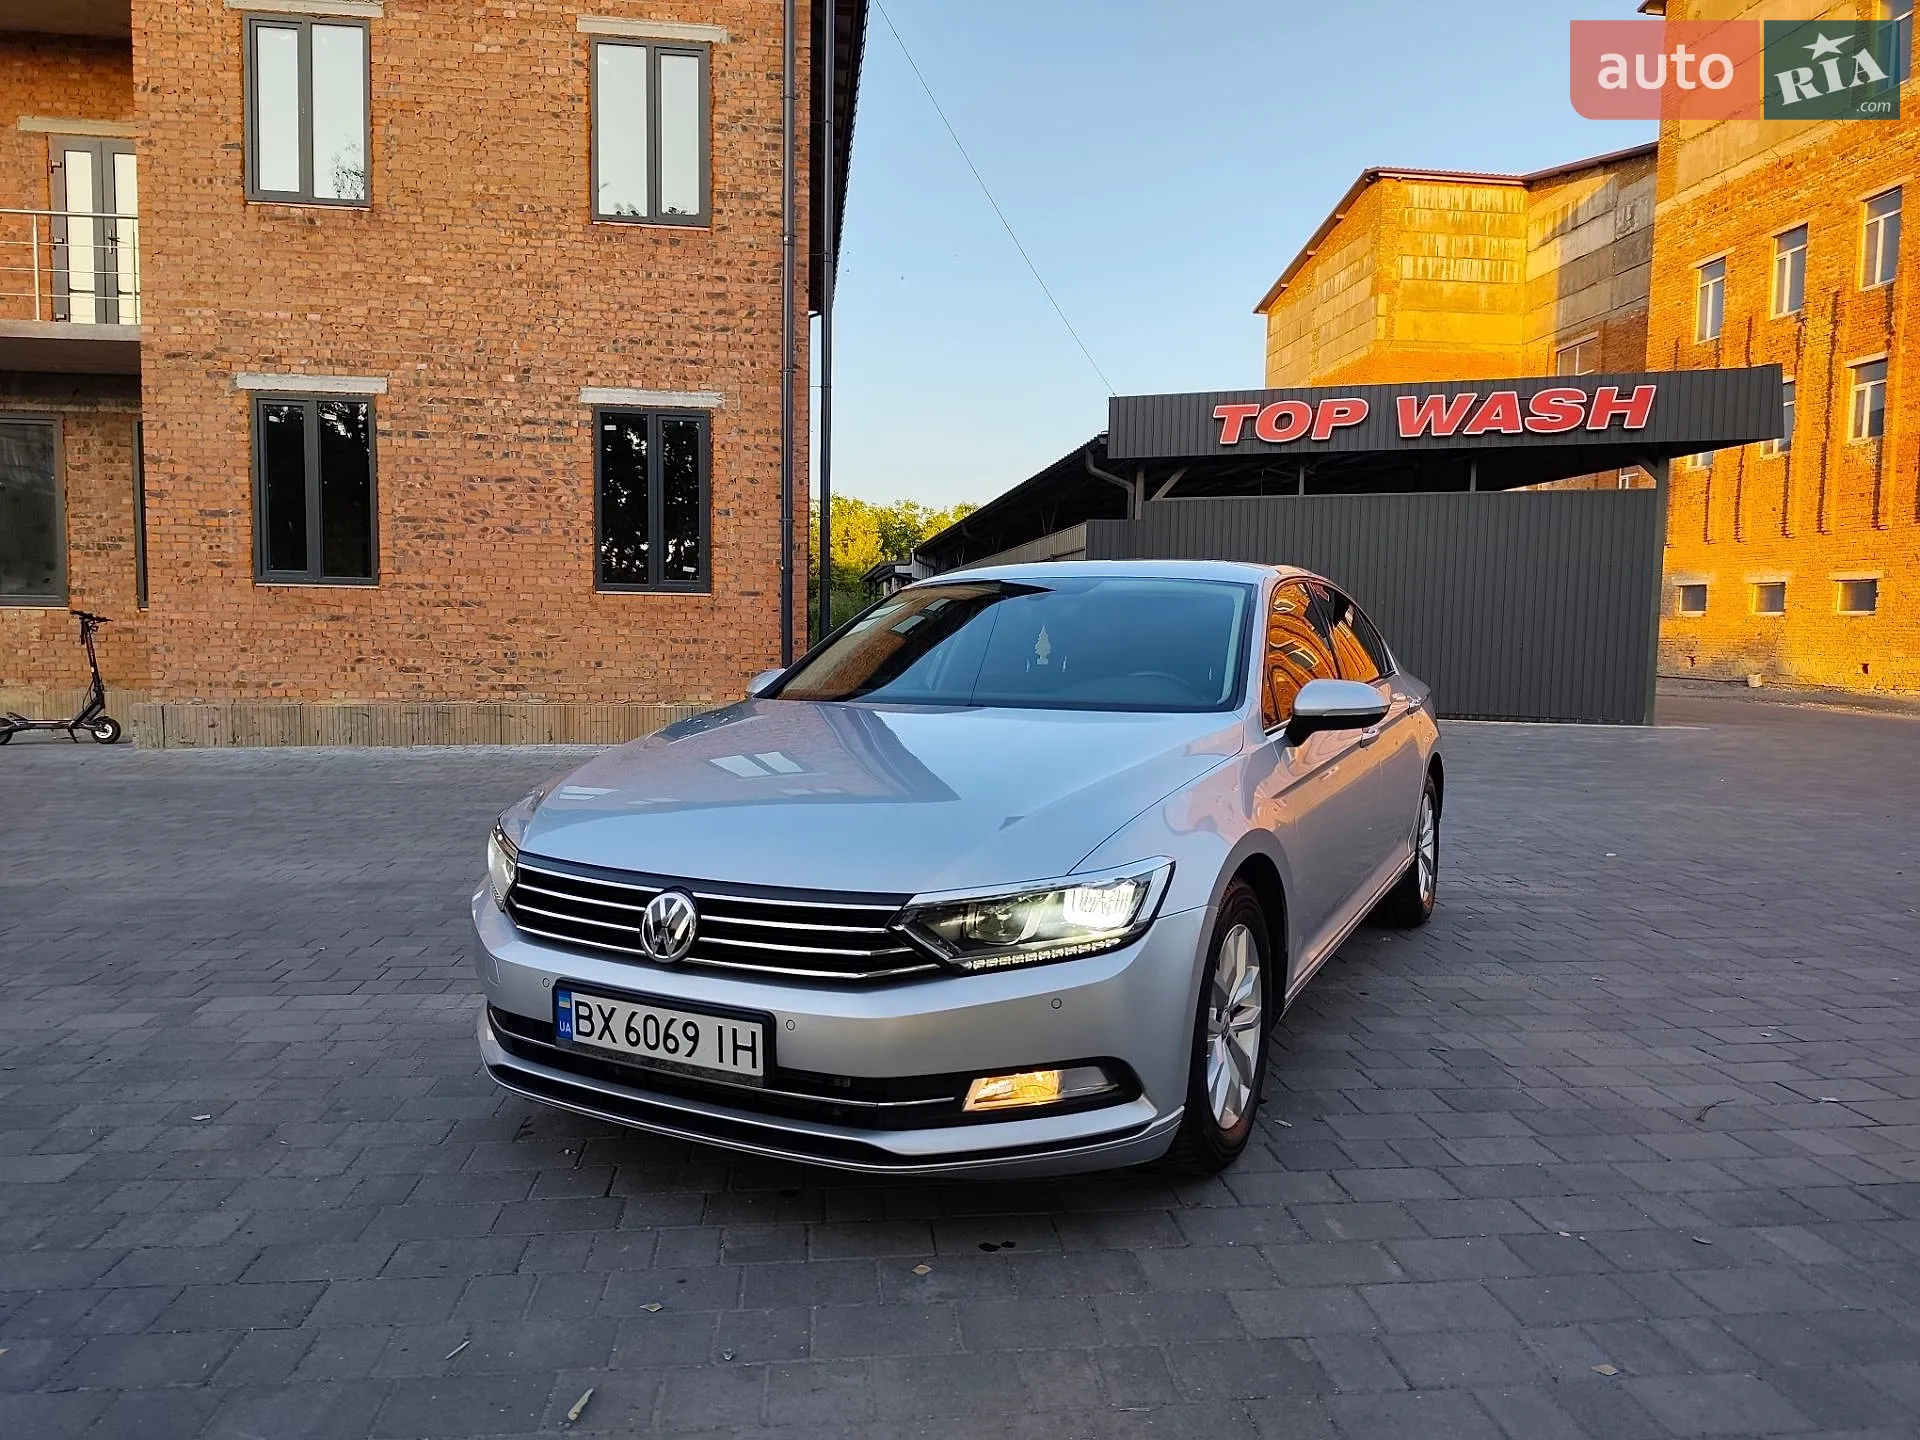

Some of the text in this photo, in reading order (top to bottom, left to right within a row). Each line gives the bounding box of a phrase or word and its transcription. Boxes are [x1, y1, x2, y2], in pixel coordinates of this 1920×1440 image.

[1212, 384, 1657, 445] TOP WASH
[559, 1019, 572, 1034] UA
[624, 1010, 700, 1058] 6069
